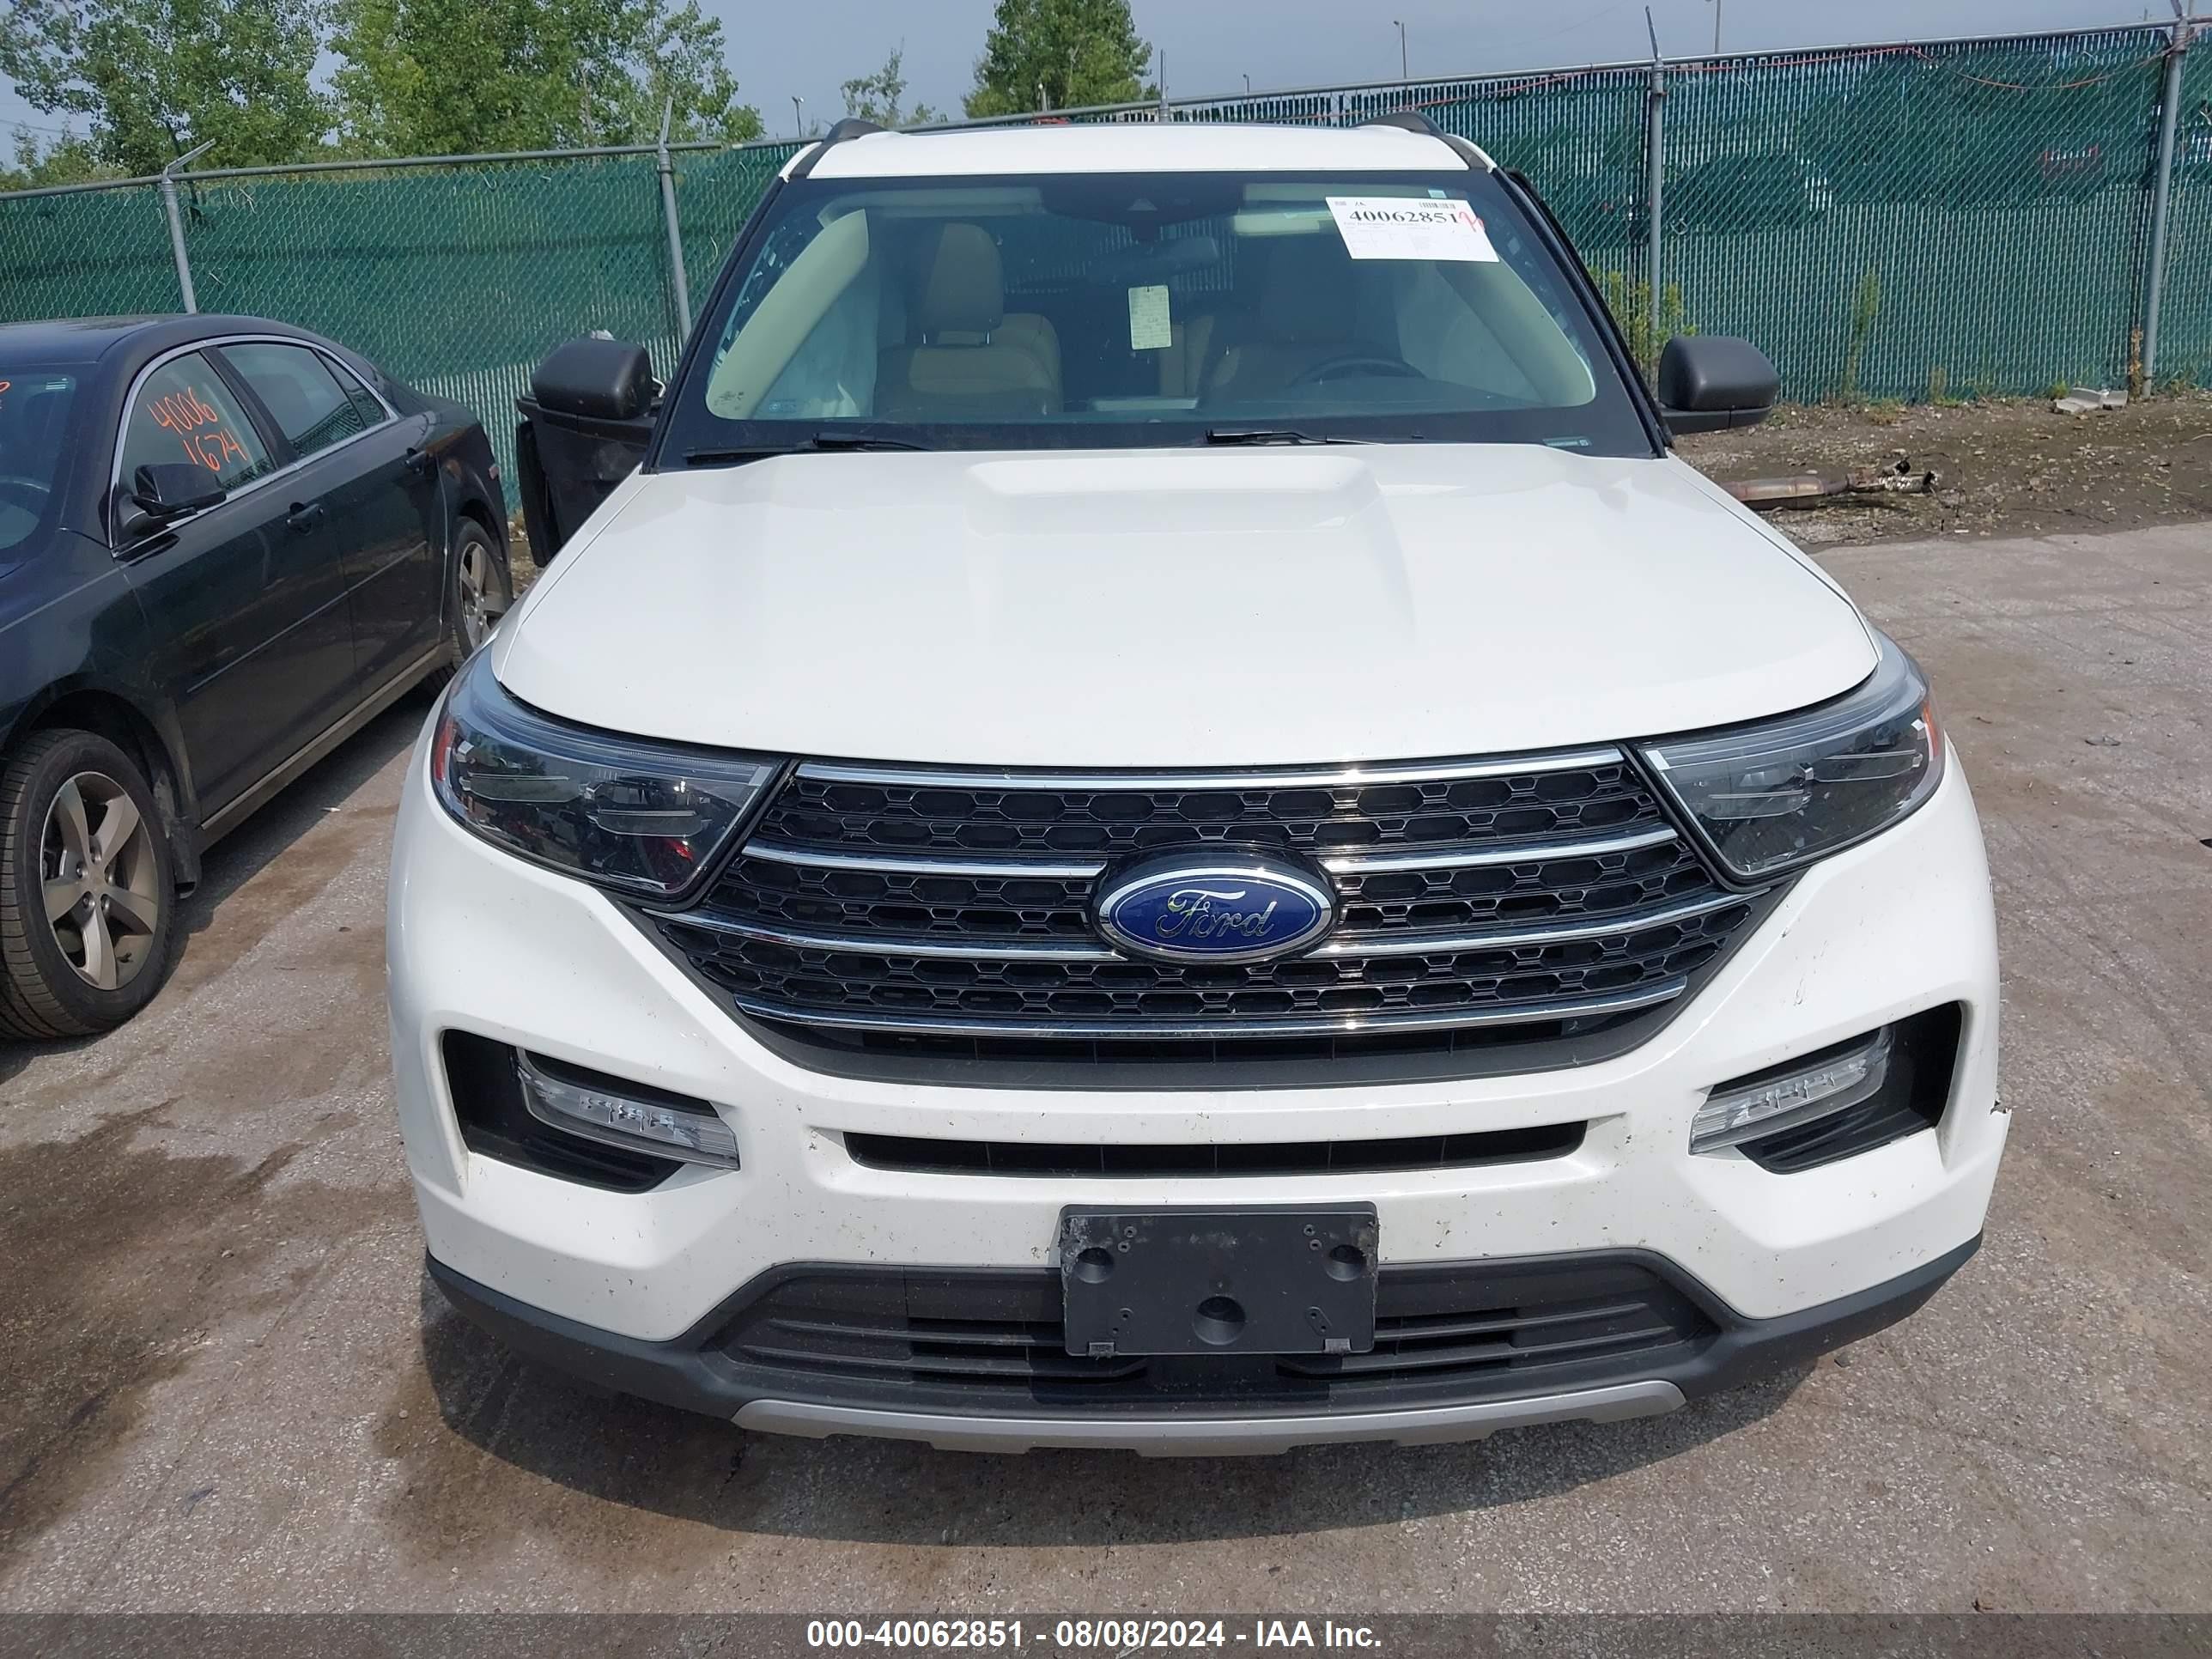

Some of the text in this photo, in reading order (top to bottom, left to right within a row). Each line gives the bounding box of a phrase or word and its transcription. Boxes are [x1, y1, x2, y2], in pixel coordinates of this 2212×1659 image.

[1349, 210, 1459, 224] 40062851
[146, 386, 218, 435] 4006
[182, 427, 248, 472] 1674
[1155, 889, 1279, 938] Ford
